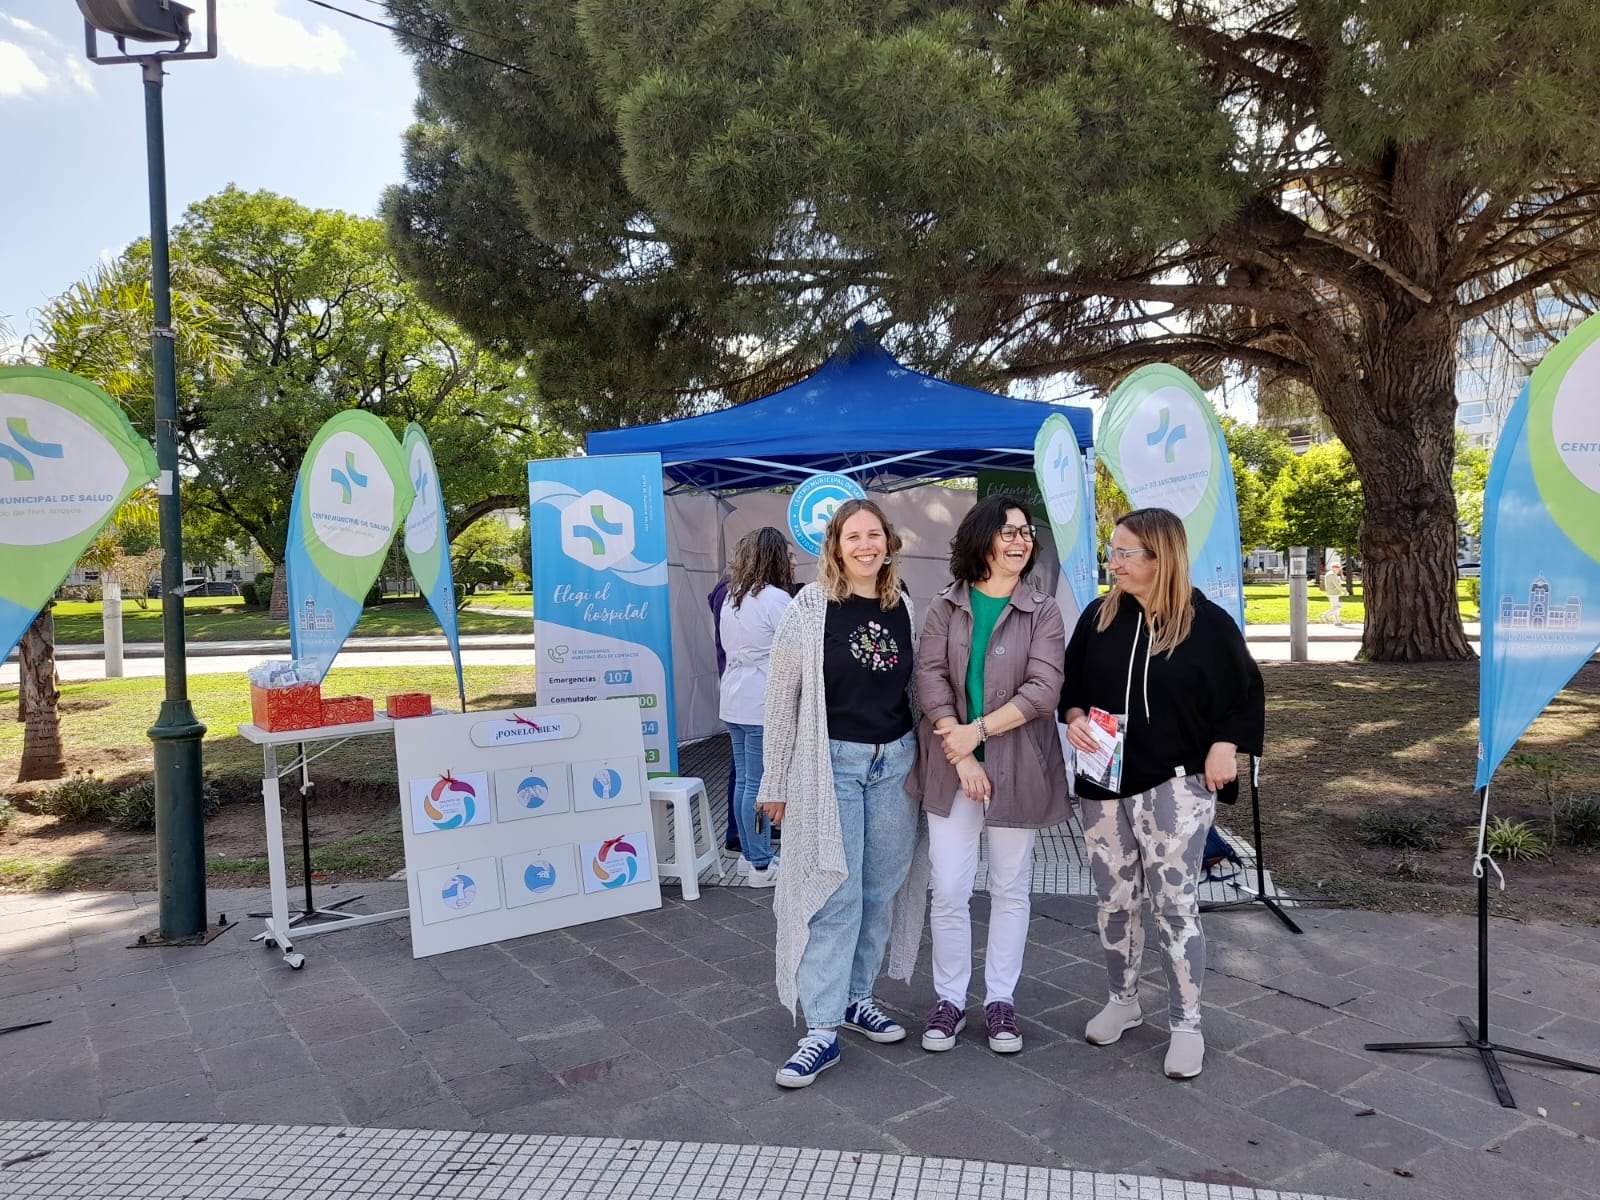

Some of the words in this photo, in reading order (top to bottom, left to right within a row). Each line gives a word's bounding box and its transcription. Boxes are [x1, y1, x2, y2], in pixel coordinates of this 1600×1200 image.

[1561, 442, 1600, 452] CENT
[61, 494, 76, 502] DE
[79, 494, 113, 502] SALUD
[595, 582, 611, 601] el
[584, 601, 649, 624] hospital
[549, 676, 596, 685] Emergencias
[608, 672, 629, 682] 107
